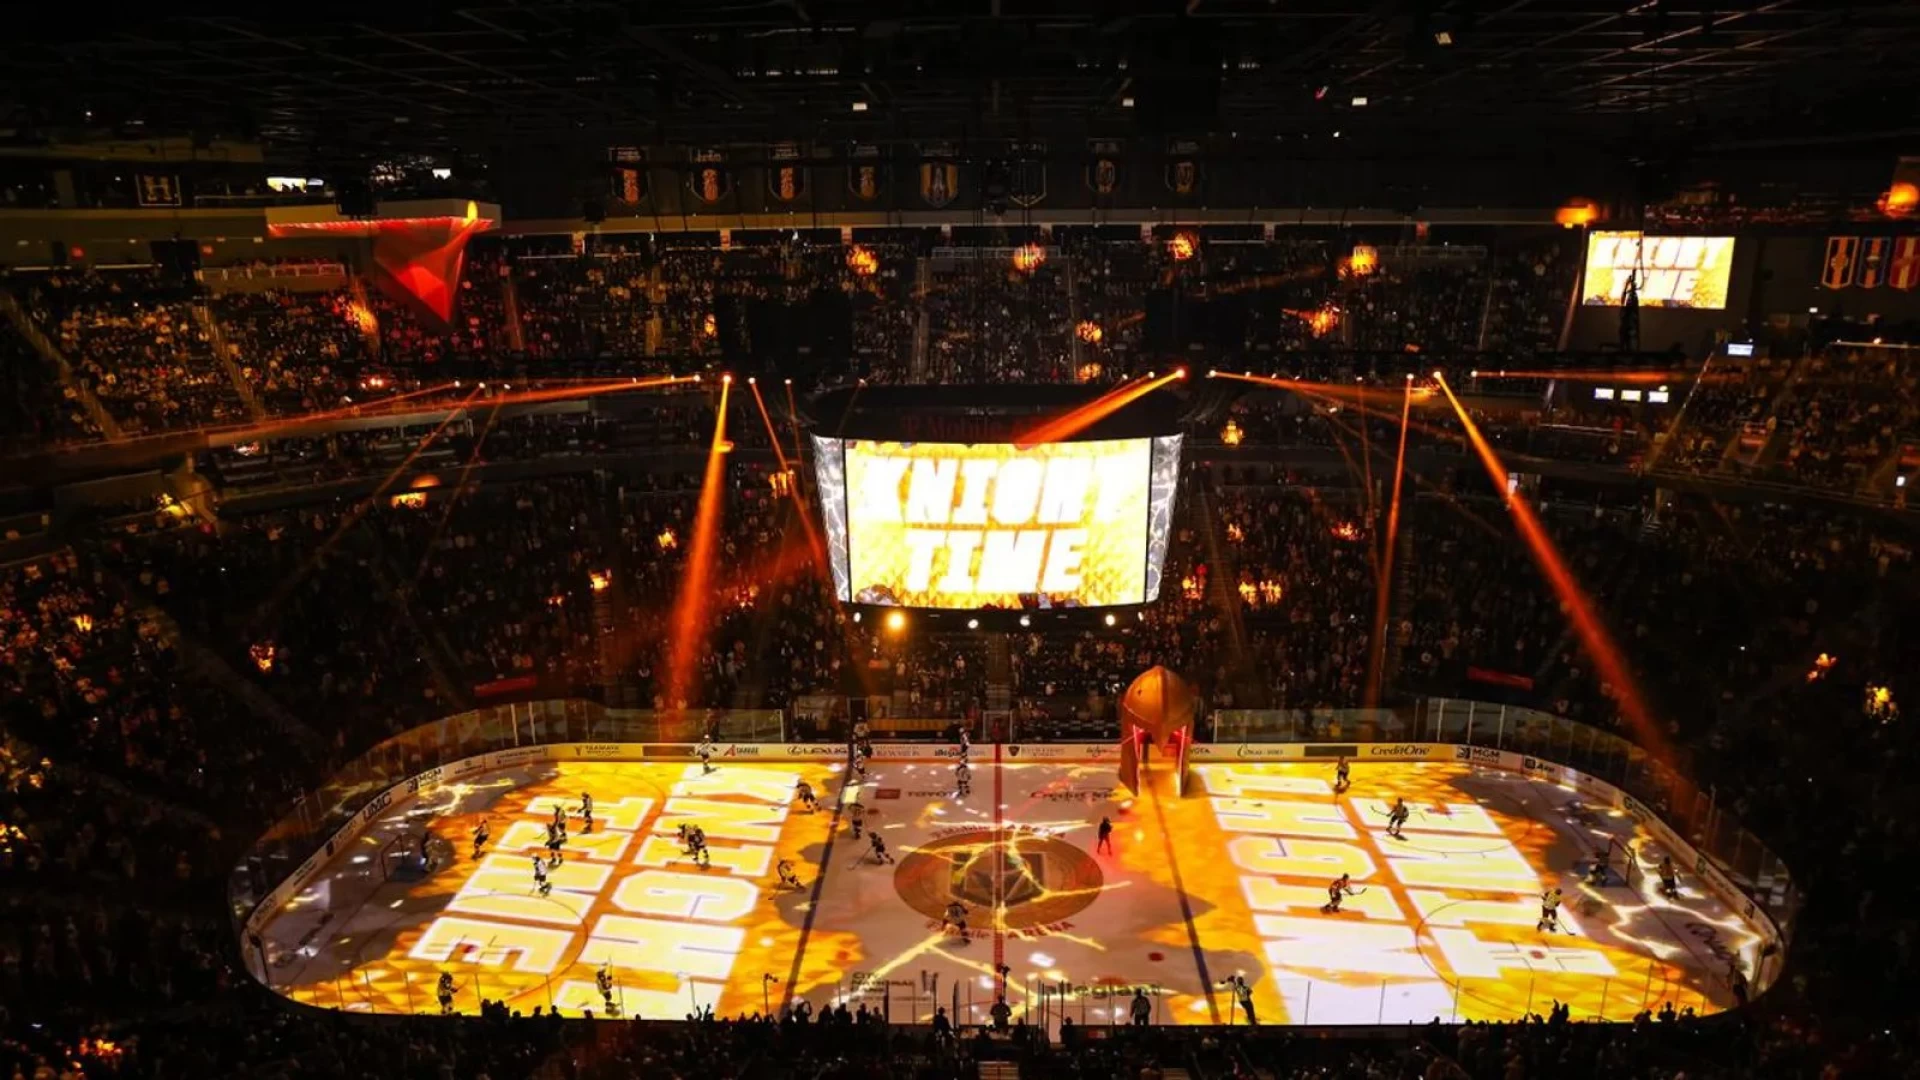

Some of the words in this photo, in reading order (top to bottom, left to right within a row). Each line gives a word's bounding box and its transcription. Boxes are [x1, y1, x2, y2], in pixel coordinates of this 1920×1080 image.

[905, 528, 1086, 592] TIME
[419, 768, 442, 783] MGM
[1473, 747, 1500, 757] MGM
[363, 791, 392, 822] UMC
[407, 796, 655, 974] TIME
[1350, 797, 1617, 978] TIME
